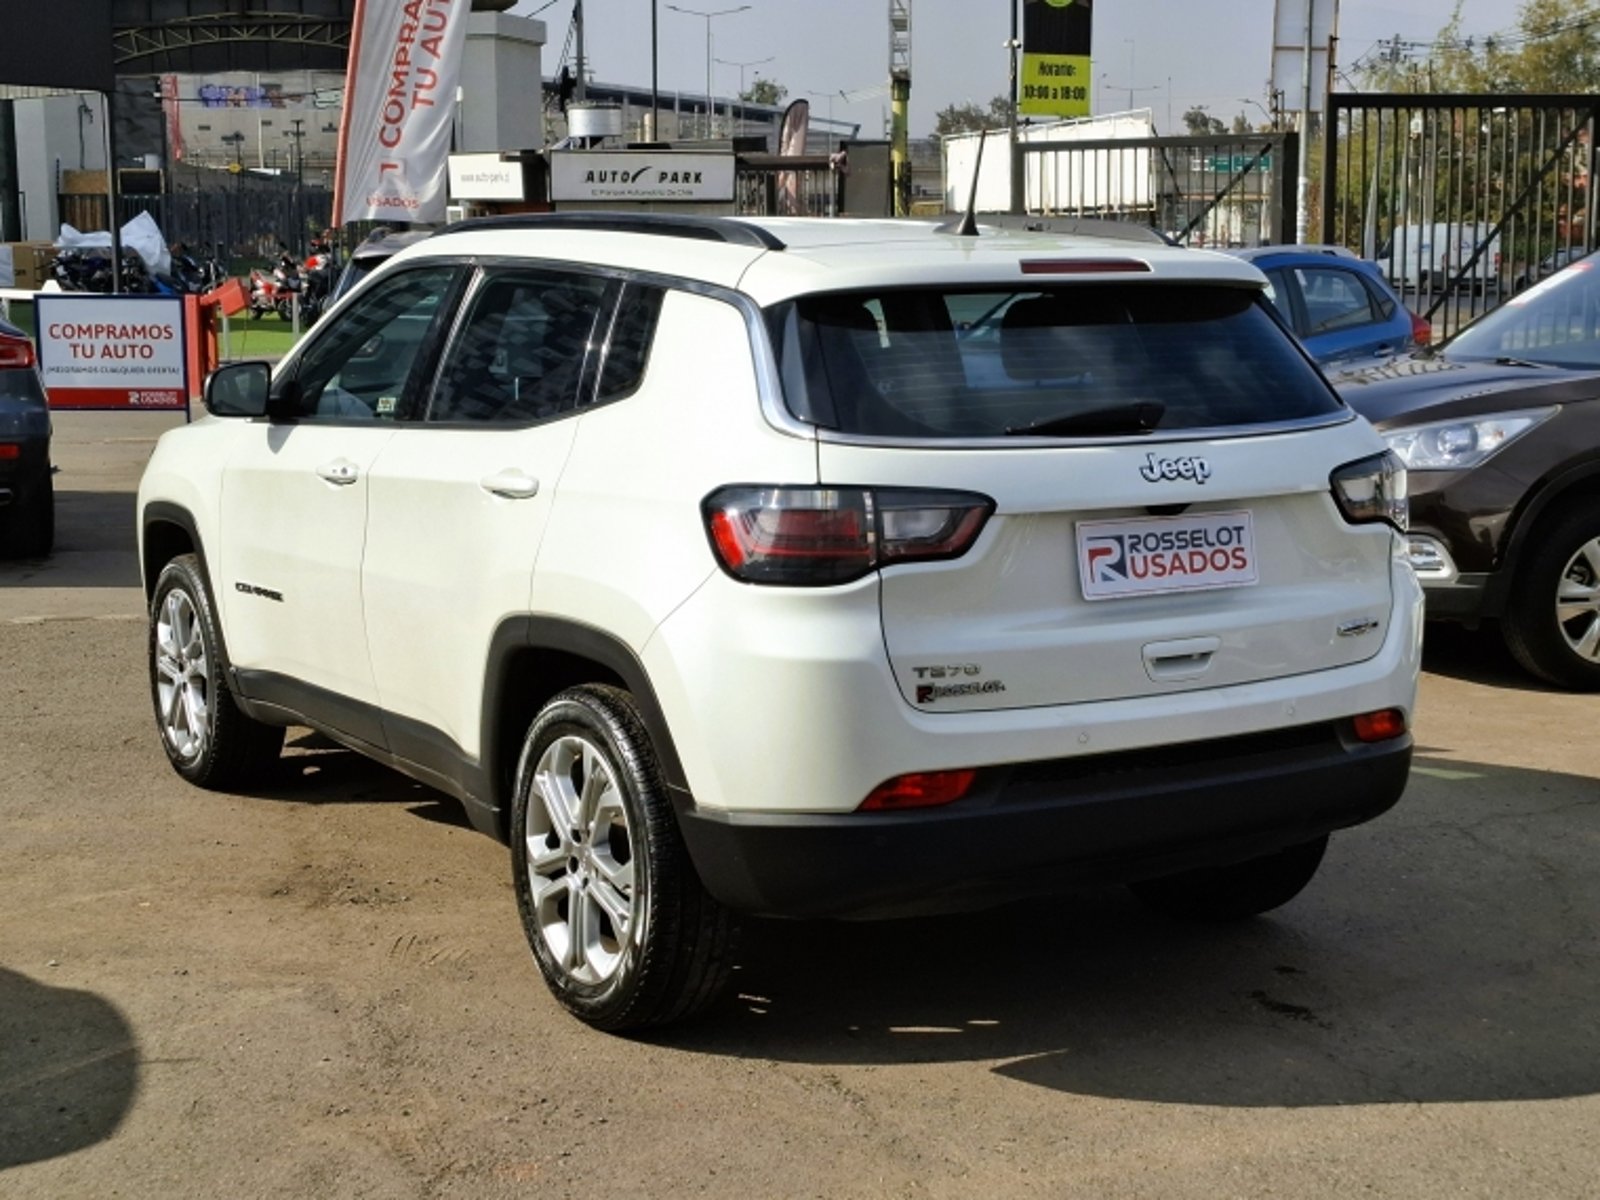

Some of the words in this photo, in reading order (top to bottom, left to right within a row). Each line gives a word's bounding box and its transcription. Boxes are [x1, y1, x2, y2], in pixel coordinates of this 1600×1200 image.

[411, 68, 437, 110] TU
[585, 170, 631, 184] AUTO
[658, 171, 702, 184] PARK
[48, 323, 174, 340] COMPRAMOS
[69, 343, 95, 359] TU
[100, 343, 154, 360] AUTO
[1139, 452, 1211, 485] Jeep
[1128, 526, 1245, 554] ROSSELOT
[1130, 547, 1247, 579] USADOS
